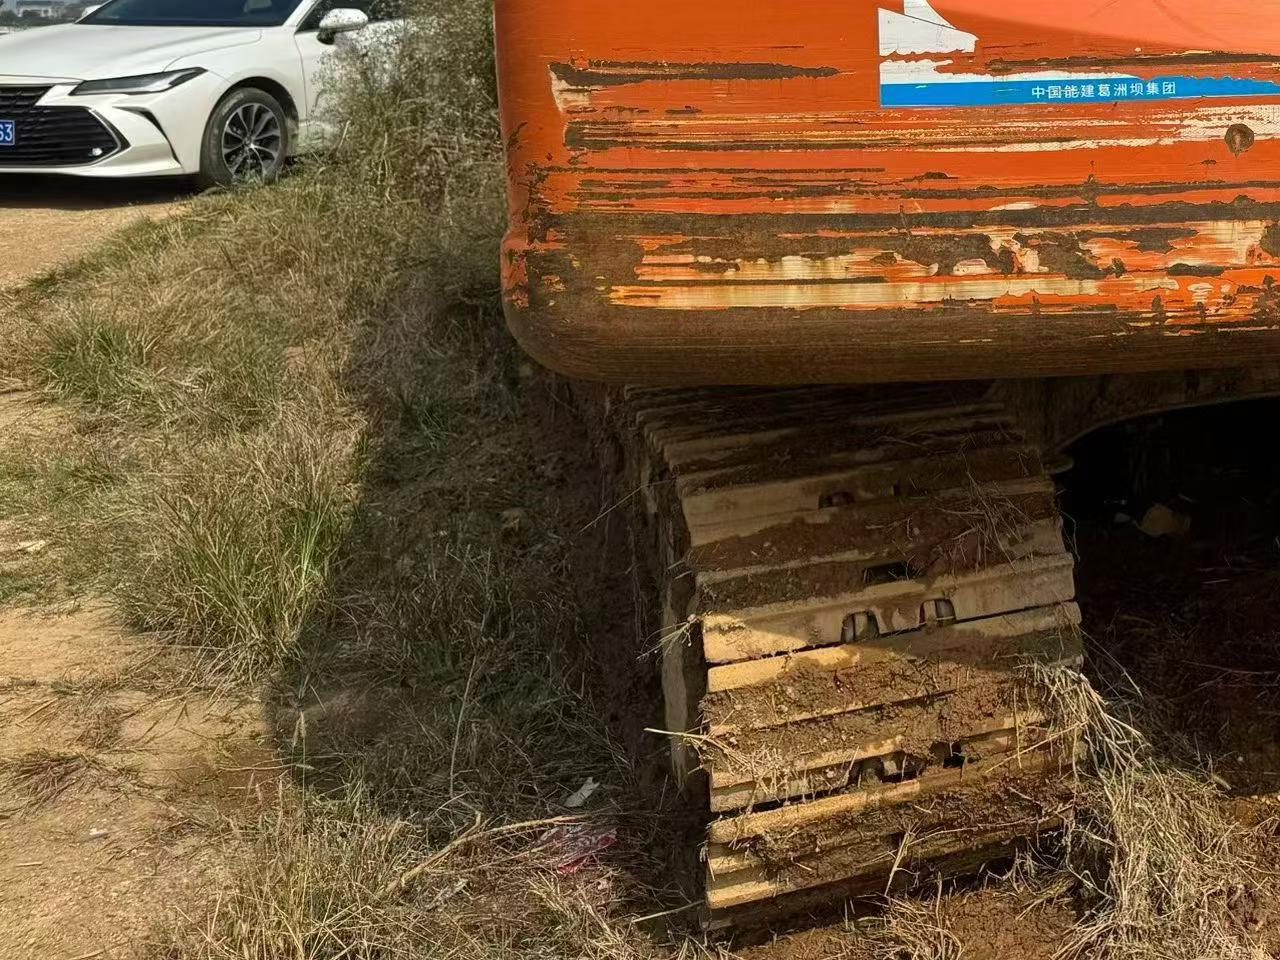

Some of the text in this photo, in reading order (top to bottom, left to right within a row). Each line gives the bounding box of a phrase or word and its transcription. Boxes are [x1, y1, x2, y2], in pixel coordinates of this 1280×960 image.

[1031, 81, 1176, 99] 中国能建葛洲坝集团
